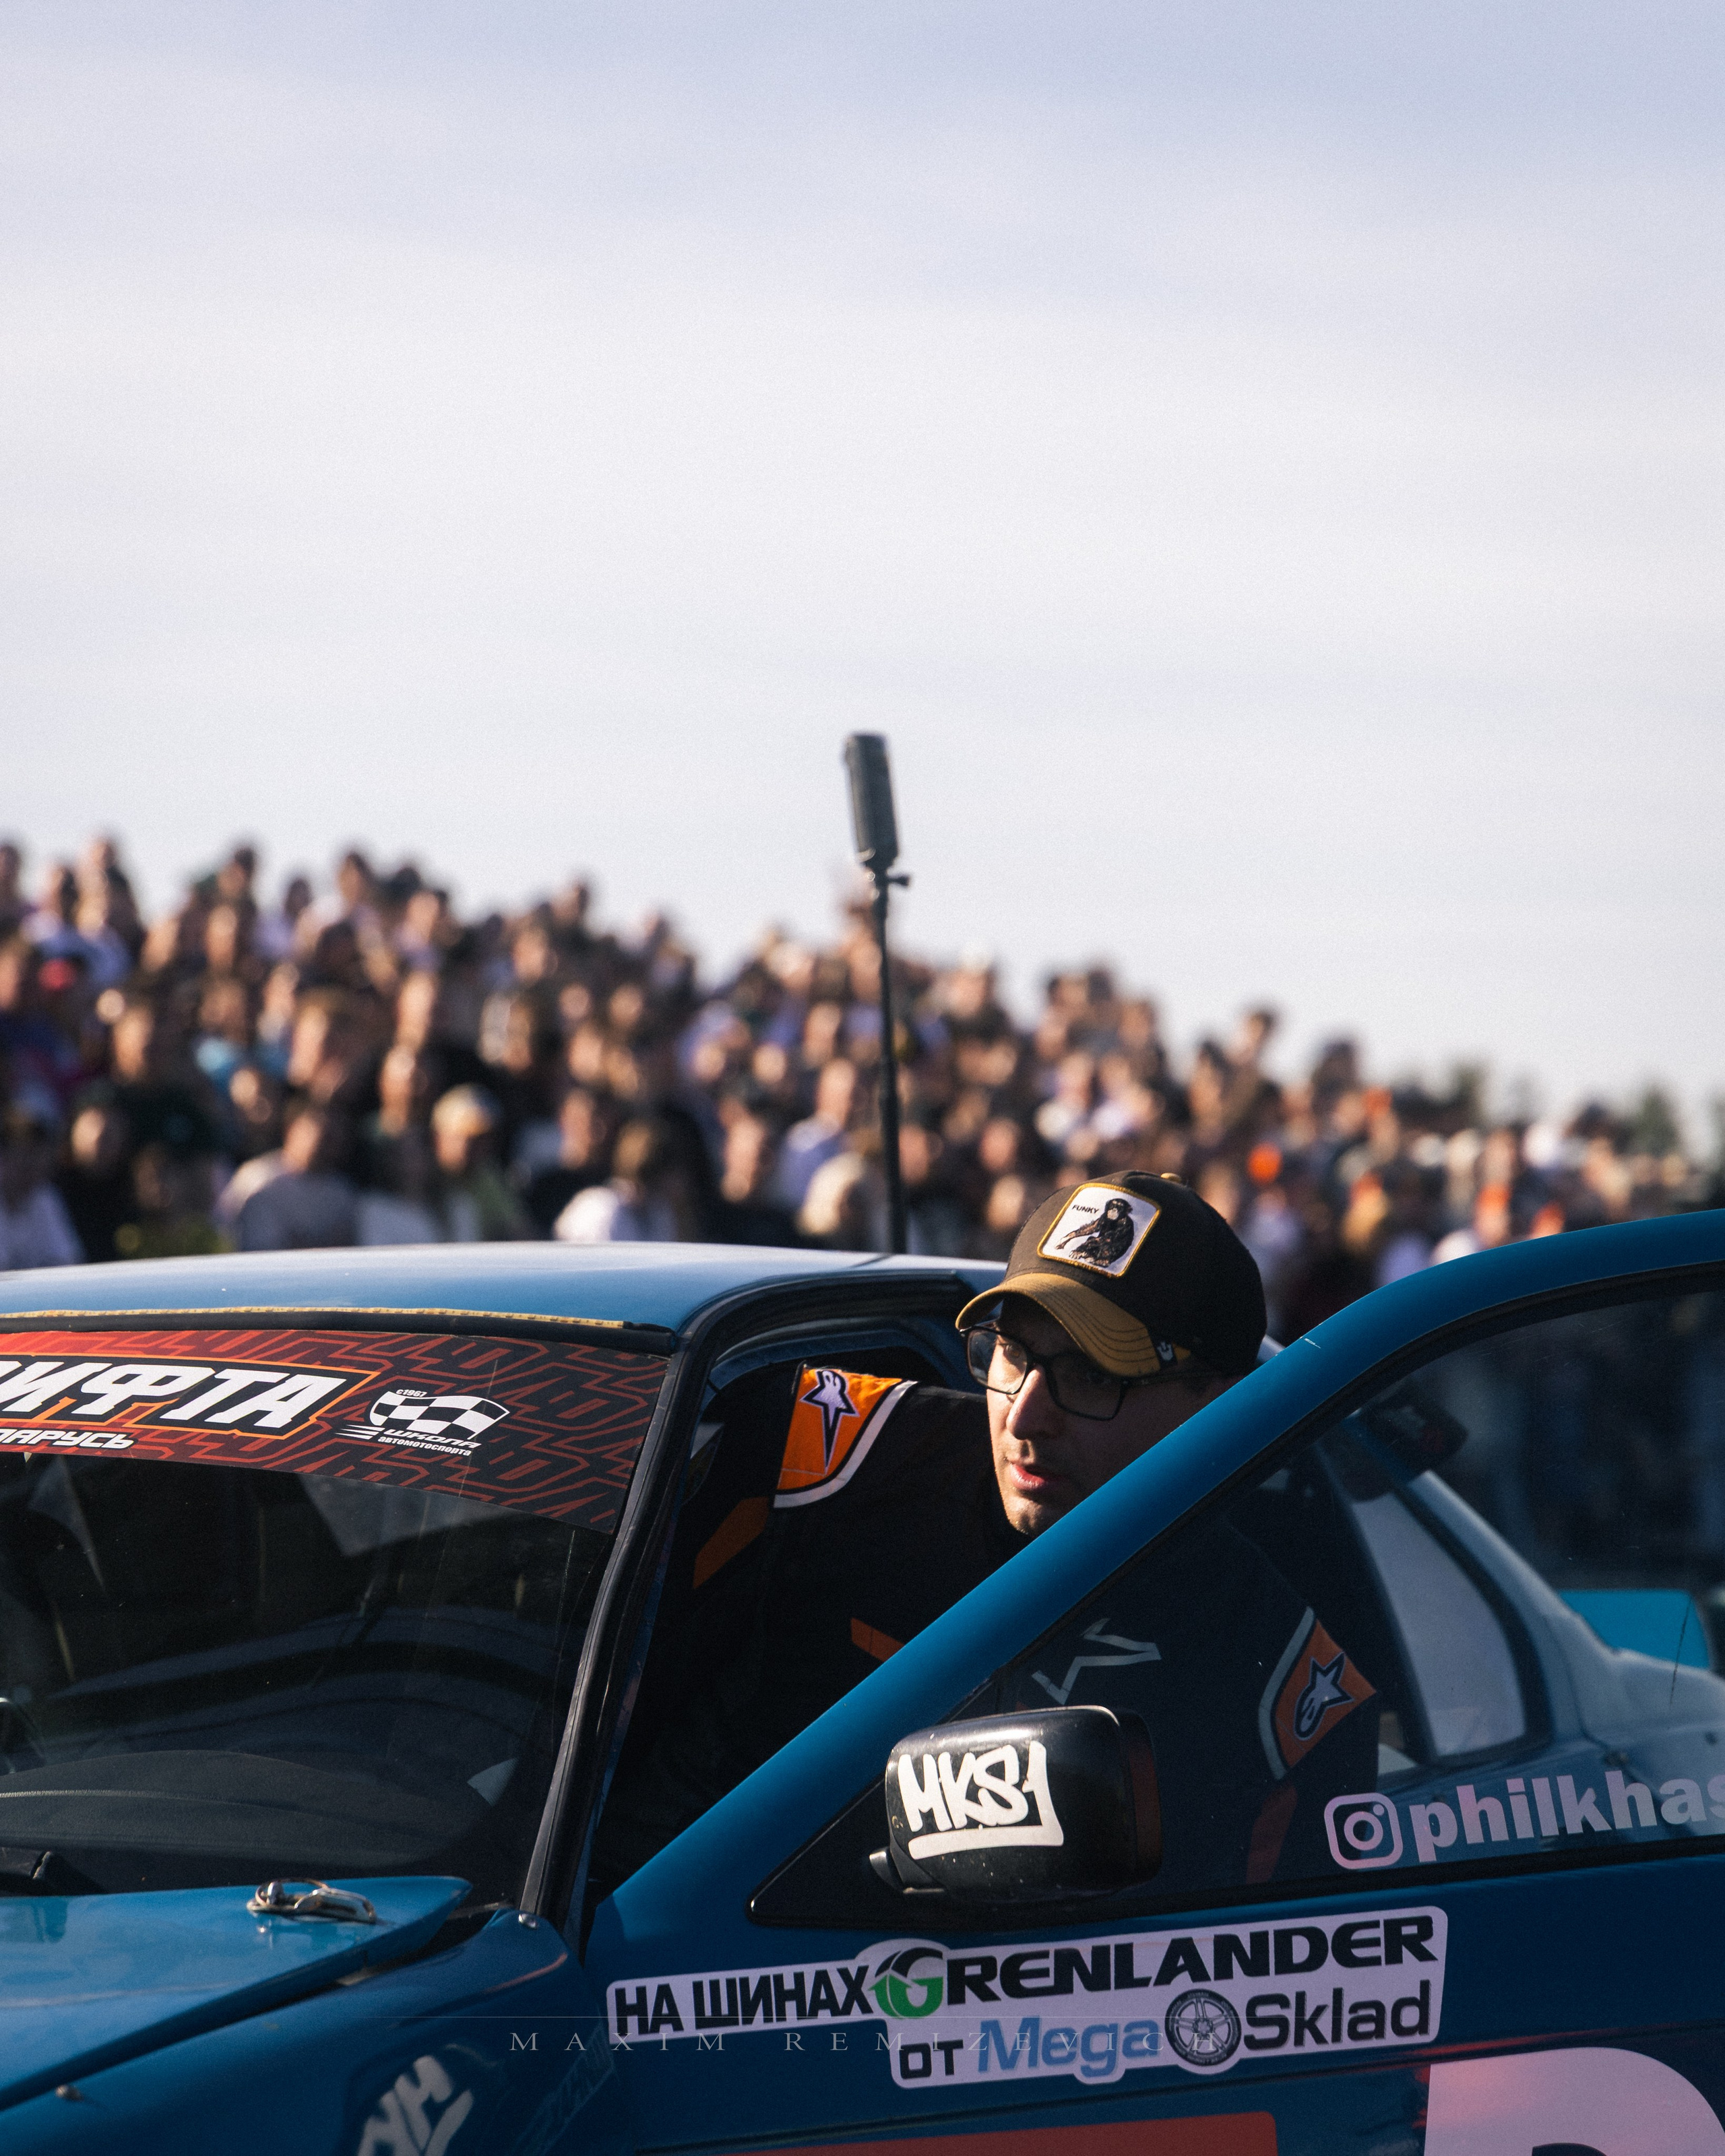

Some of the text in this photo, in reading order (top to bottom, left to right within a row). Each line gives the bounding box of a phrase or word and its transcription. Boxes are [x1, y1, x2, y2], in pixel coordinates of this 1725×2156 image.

[1072, 1205, 1099, 1214] FUNKY
[377, 1436, 472, 1457] автомотоспорта
[615, 1915, 1438, 2037] НА ШИНАХ GRENLANDER
